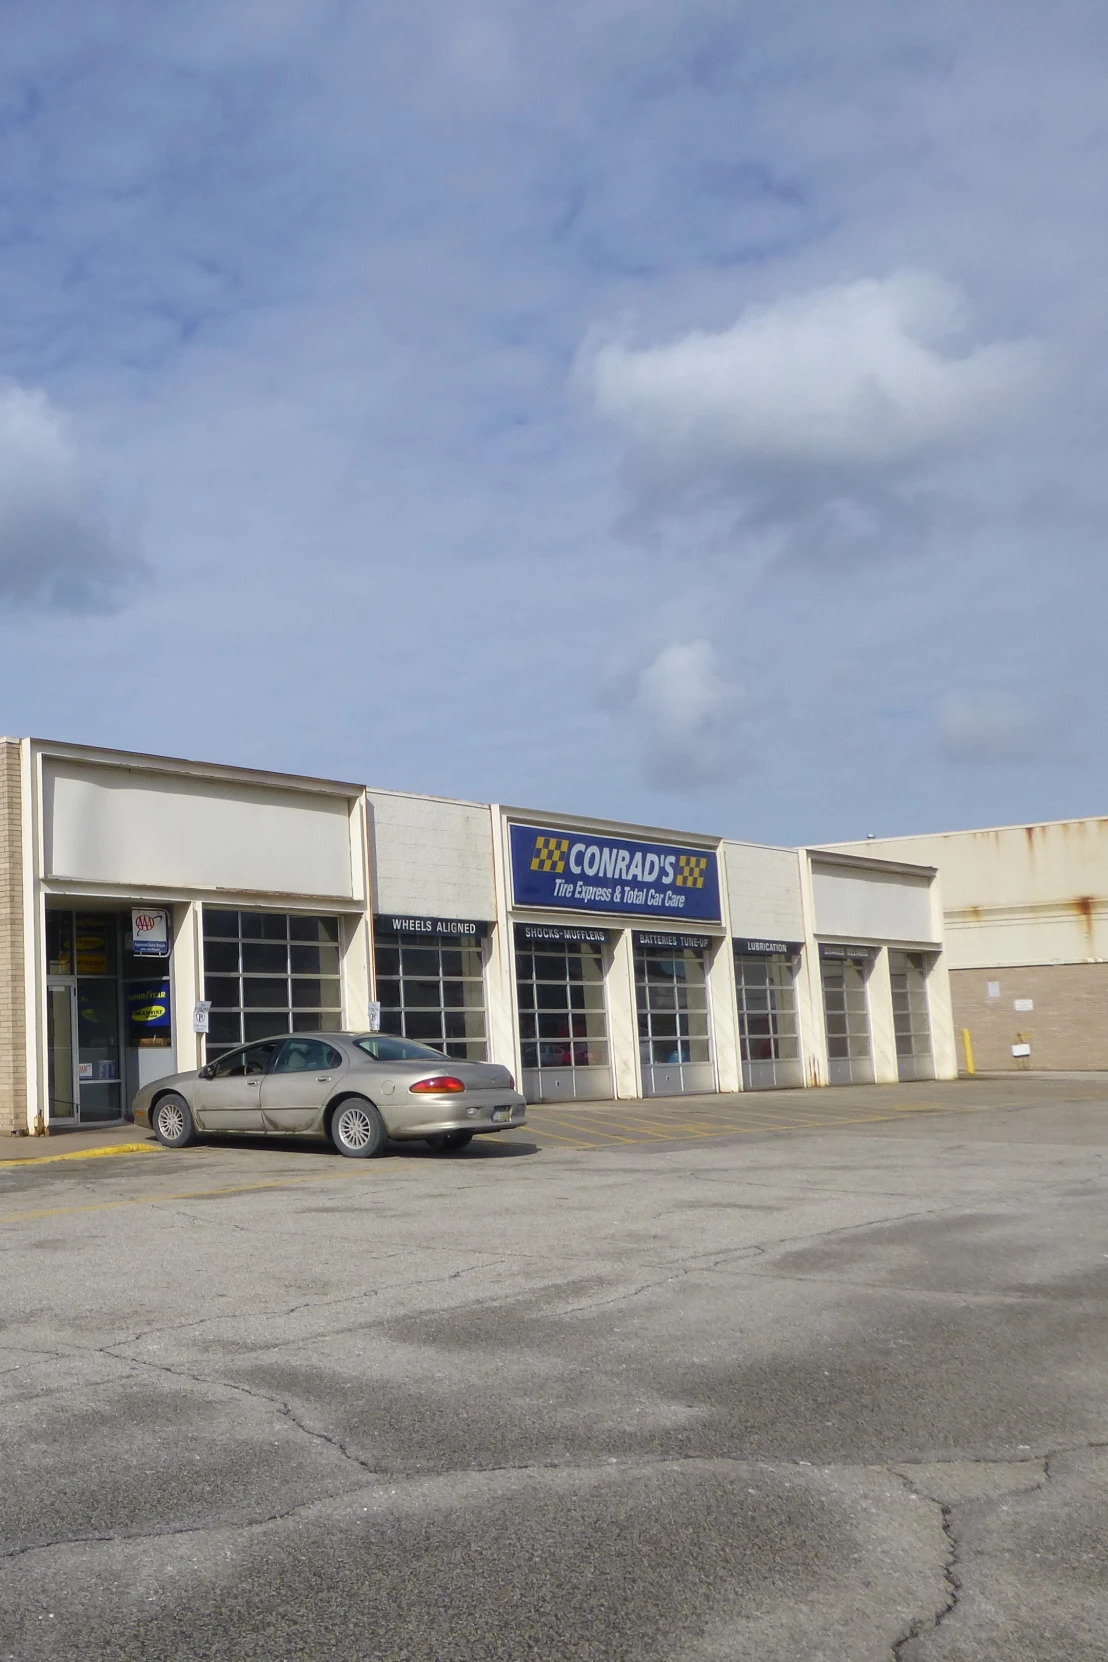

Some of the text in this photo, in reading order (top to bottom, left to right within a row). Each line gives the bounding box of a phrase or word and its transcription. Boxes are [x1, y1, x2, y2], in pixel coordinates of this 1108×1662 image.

[569, 843, 676, 885] CONRAD'S
[553, 879, 685, 908] Tire Express & Total Car Care
[392, 918, 476, 934] WHEELS ALIGNED
[639, 934, 709, 948] BATTERIES TUNE-UP
[747, 942, 787, 953] LUBRICATION
